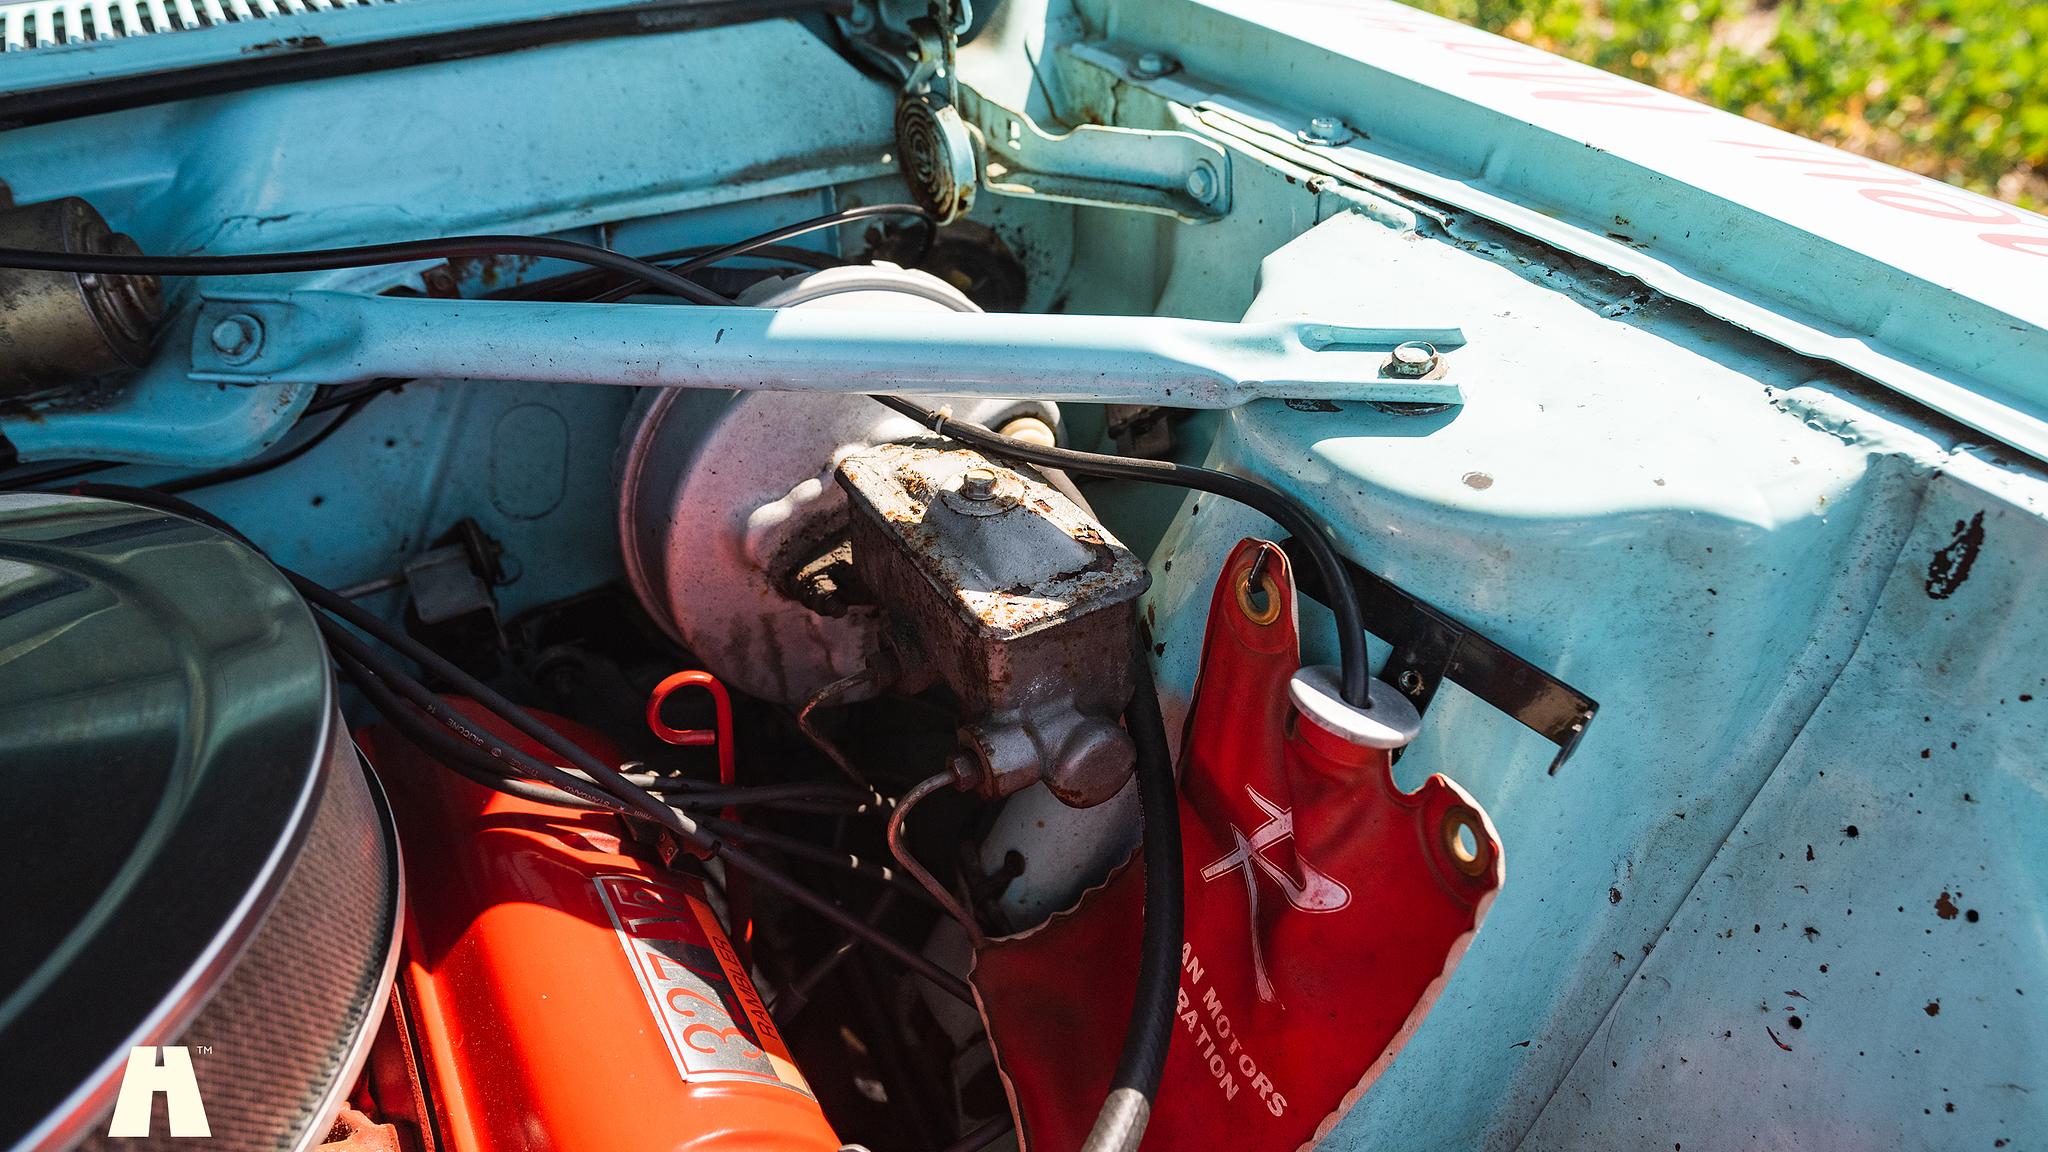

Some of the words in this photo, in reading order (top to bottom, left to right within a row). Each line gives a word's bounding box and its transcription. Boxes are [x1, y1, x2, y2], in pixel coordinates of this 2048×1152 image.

[446, 717, 485, 747] SILICONE
[644, 951, 762, 1060] 327
[714, 935, 779, 1041] RAMBLER
[1202, 986, 1288, 1117] MOTORS
